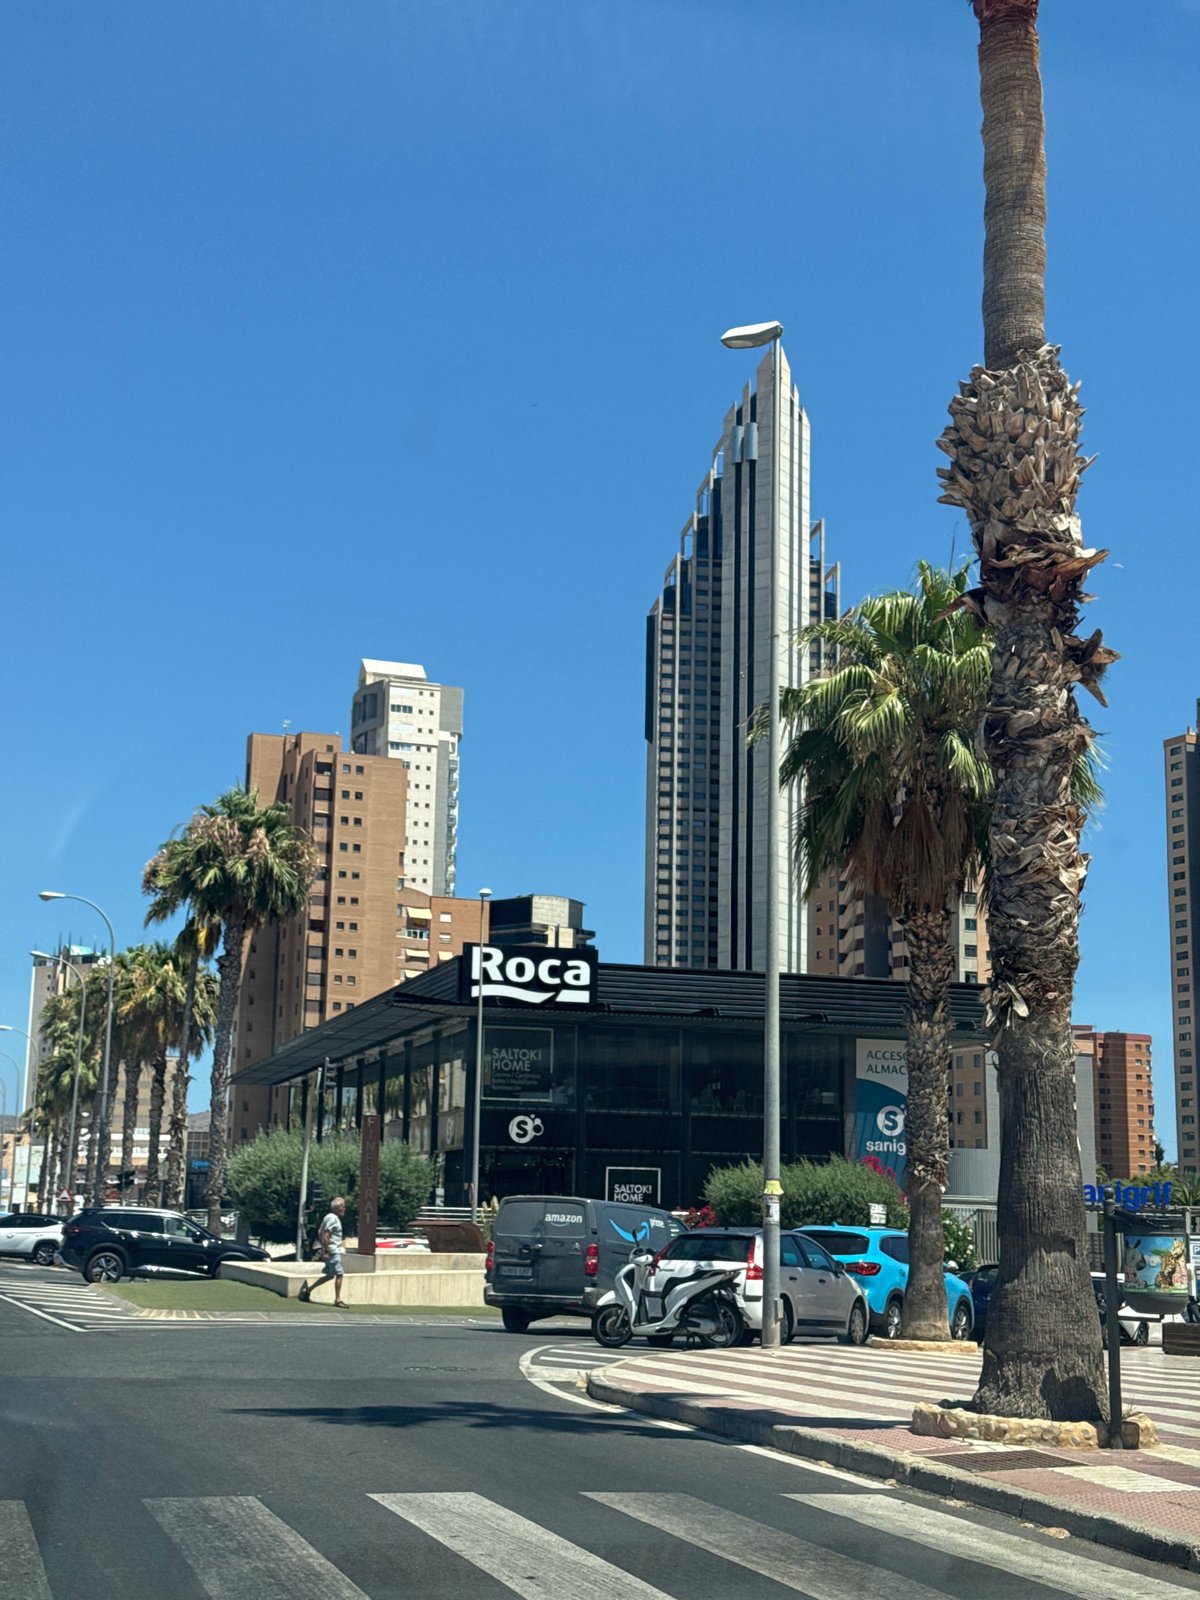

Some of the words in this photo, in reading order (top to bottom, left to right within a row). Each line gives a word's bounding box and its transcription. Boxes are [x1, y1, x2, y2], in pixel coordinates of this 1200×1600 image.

[471, 946, 591, 986] Roca
[492, 1047, 542, 1060] SALTOKI
[492, 1060, 531, 1072] HOME
[364, 1117, 376, 1224] FINESTRAT
[613, 1184, 653, 1194] SALTOKI
[613, 1193, 644, 1203] HOME
[544, 1213, 583, 1224] amazon
